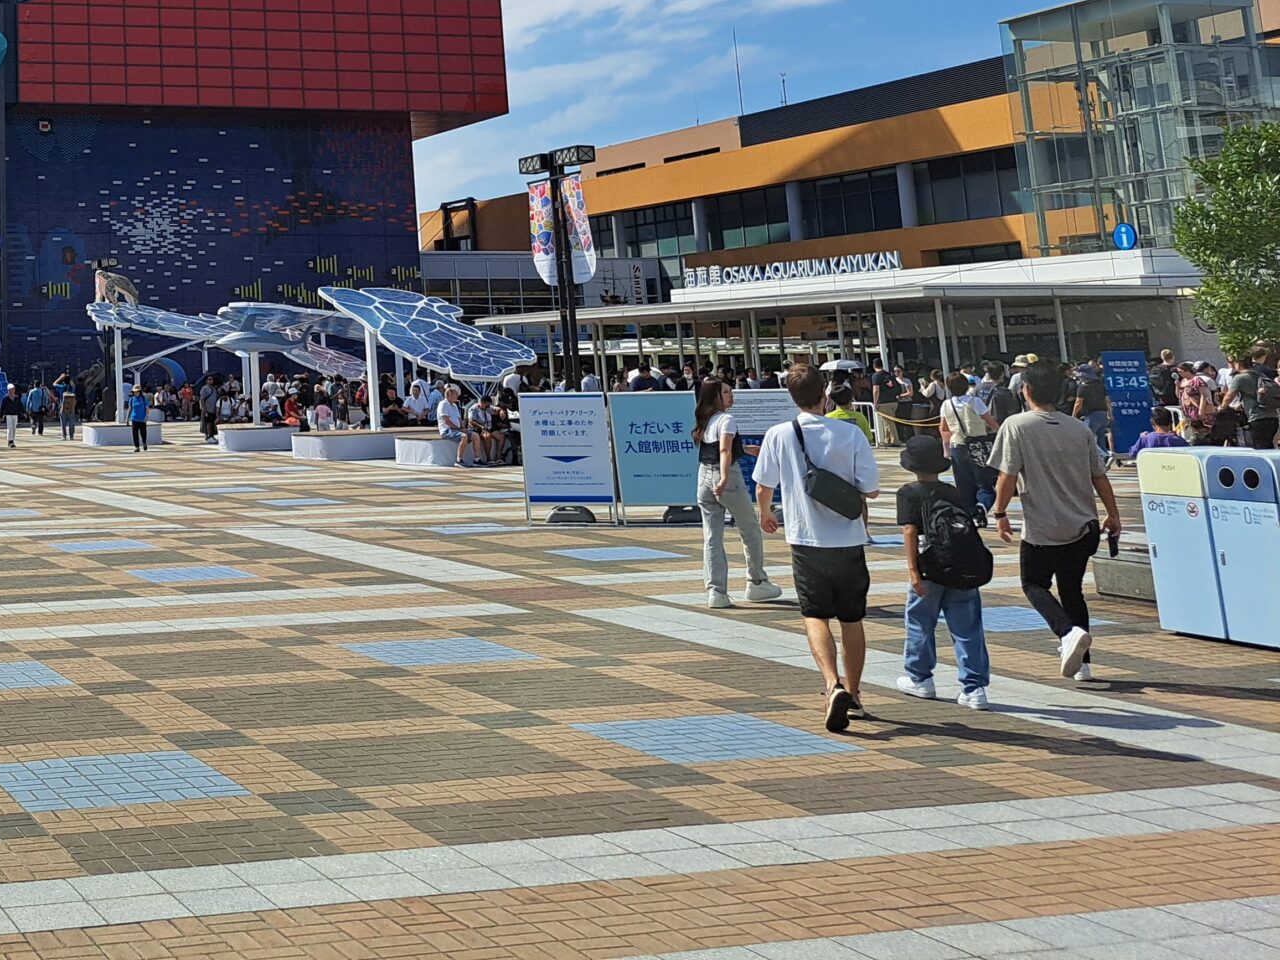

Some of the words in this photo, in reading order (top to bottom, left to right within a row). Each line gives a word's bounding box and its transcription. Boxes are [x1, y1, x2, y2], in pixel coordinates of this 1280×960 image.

[723, 264, 761, 283] OSAKA
[764, 257, 827, 280] AQUARIUM
[829, 250, 899, 274] KAIYUKAN
[1106, 375, 1148, 388] 13:45
[628, 421, 684, 434] ただいま
[624, 439, 694, 454] 入館制限中
